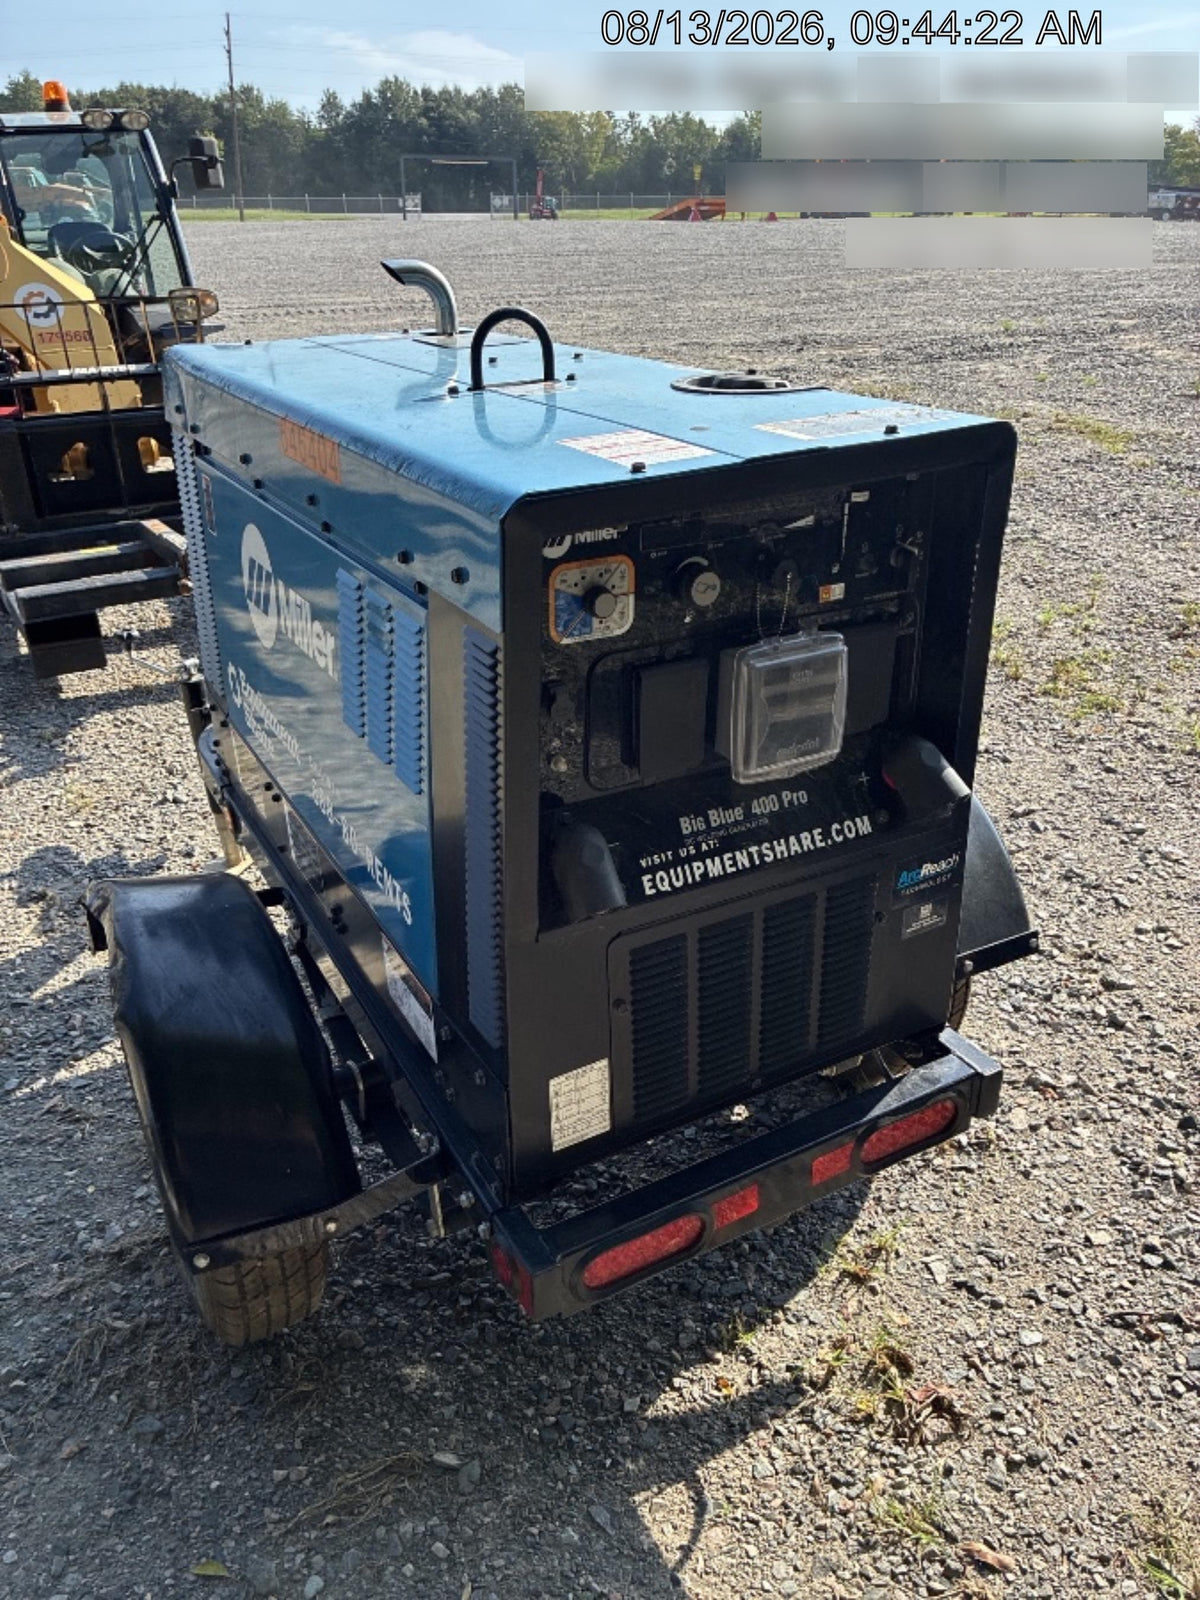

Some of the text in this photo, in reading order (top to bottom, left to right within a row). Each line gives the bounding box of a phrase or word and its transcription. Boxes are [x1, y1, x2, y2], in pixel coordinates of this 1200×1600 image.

[574, 526, 619, 545] Miller
[277, 577, 336, 677] Miller
[707, 806, 744, 828] Blue
[751, 794, 780, 816] 400
[782, 790, 808, 808] Pro
[639, 839, 719, 868] VISIT US AT:
[641, 815, 873, 896] EQUIPMENTSHARE.COM
